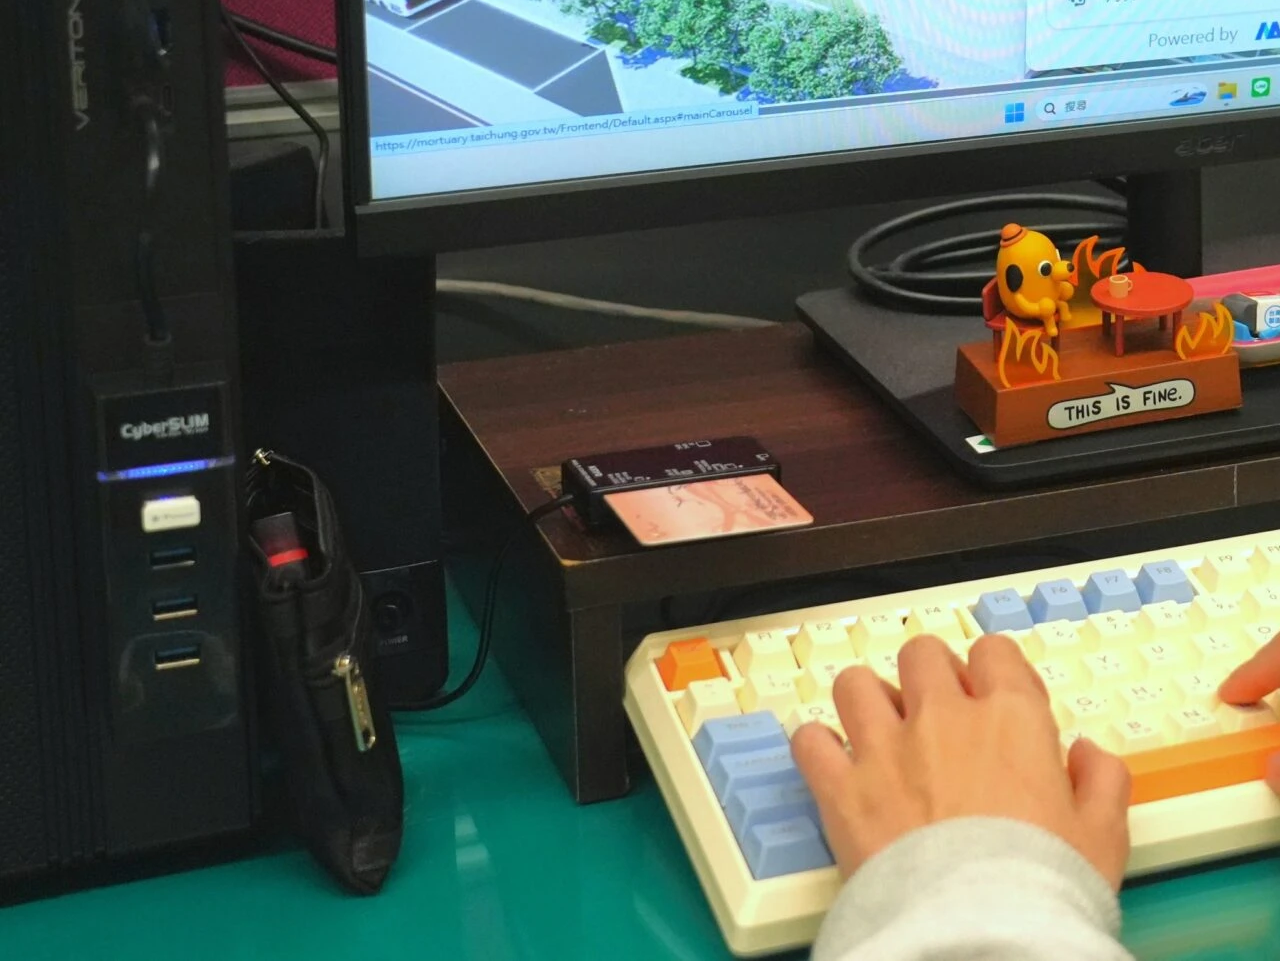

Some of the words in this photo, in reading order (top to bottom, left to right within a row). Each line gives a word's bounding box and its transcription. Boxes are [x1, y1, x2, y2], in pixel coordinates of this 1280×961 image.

[1149, 27, 1215, 47] Powered
[1219, 26, 1239, 45] by
[1064, 400, 1102, 421] THIS
[1116, 395, 1131, 411] IS
[1218, 554, 1233, 563] F9
[1156, 566, 1172, 576] F8
[1104, 575, 1119, 585] F7
[1051, 586, 1068, 595] F6
